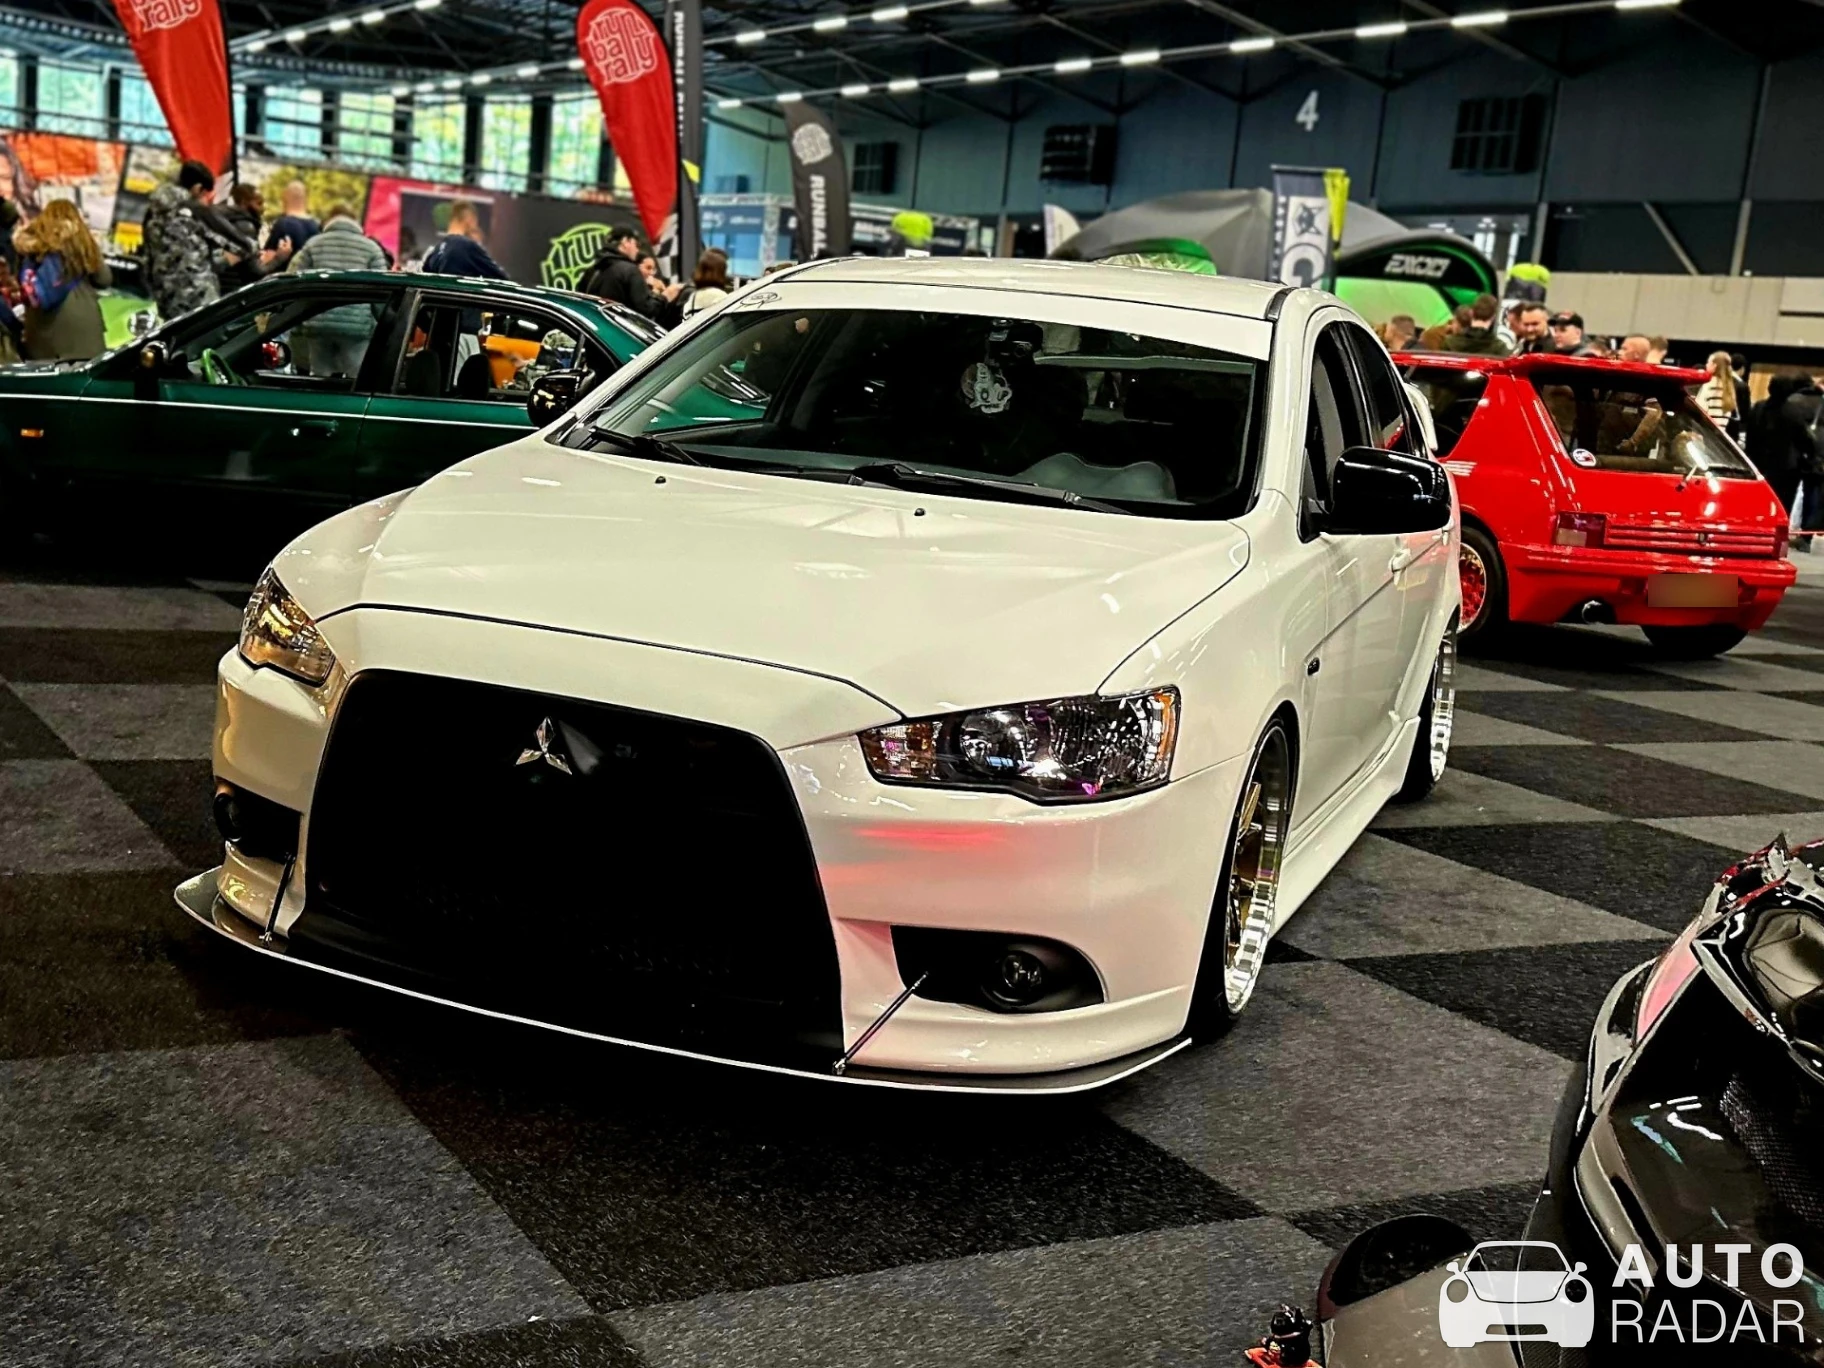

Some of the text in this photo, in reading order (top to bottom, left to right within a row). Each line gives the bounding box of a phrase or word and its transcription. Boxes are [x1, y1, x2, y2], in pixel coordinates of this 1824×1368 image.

[593, 10, 644, 41] run
[603, 47, 656, 80] rally
[1296, 90, 1319, 131] 4
[810, 174, 828, 259] RUNBAL
[556, 231, 607, 266] ru
